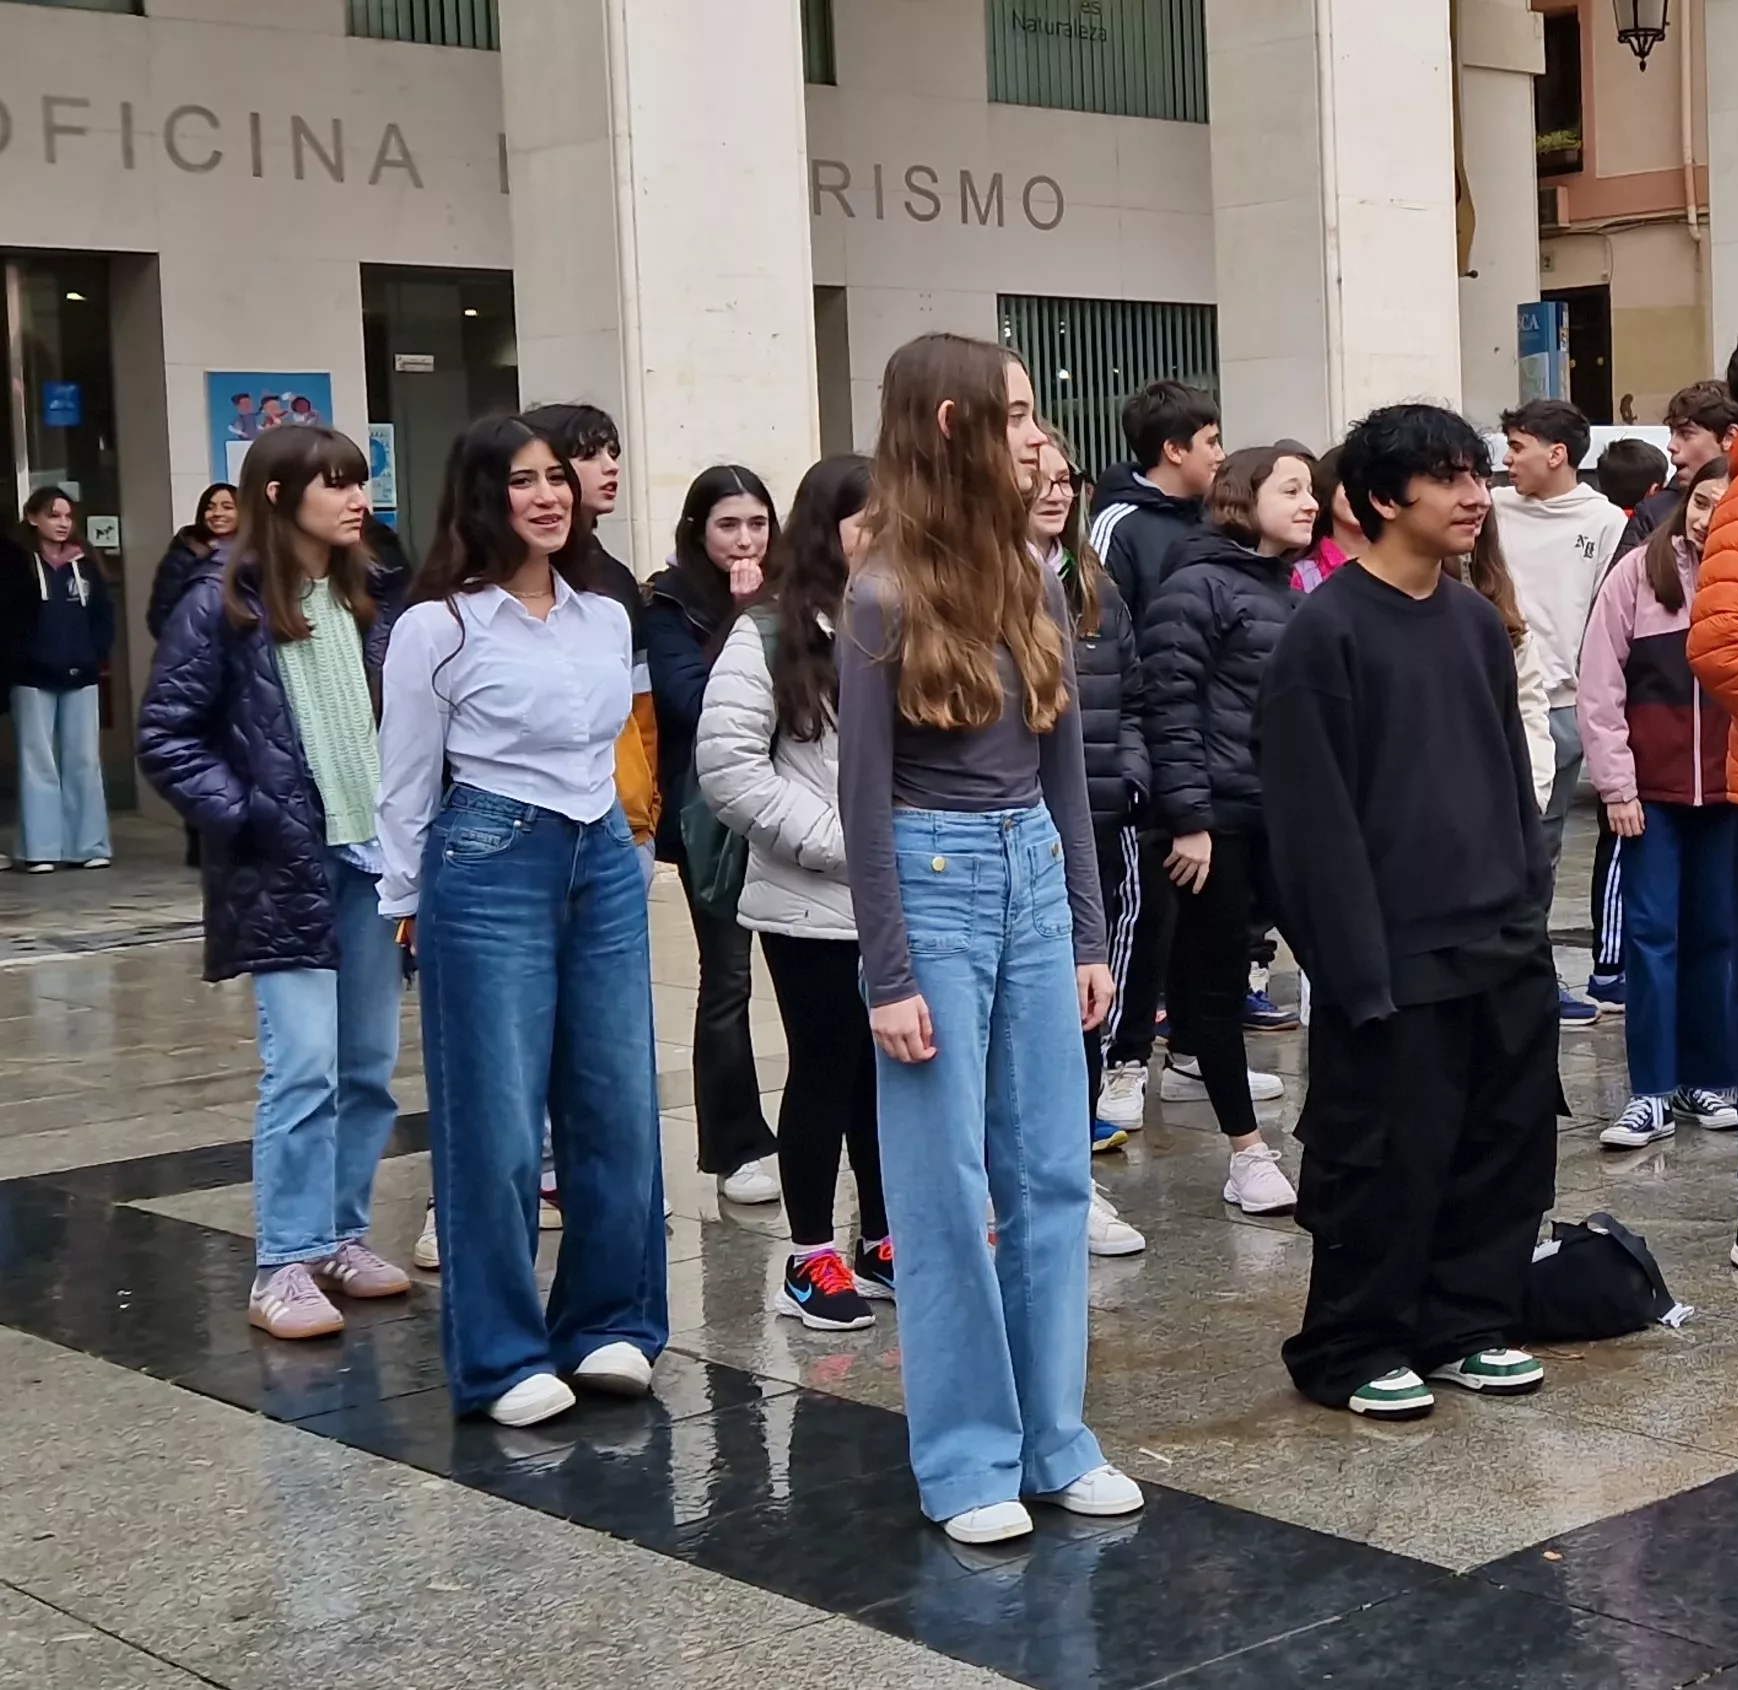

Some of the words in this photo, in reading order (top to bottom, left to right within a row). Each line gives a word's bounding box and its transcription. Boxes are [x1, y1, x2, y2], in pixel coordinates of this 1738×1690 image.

[1080, 1, 1101, 15] es
[1012, 8, 1107, 41] Naturaleza
[0, 94, 424, 189] FICINA
[1517, 313, 1540, 331] CA
